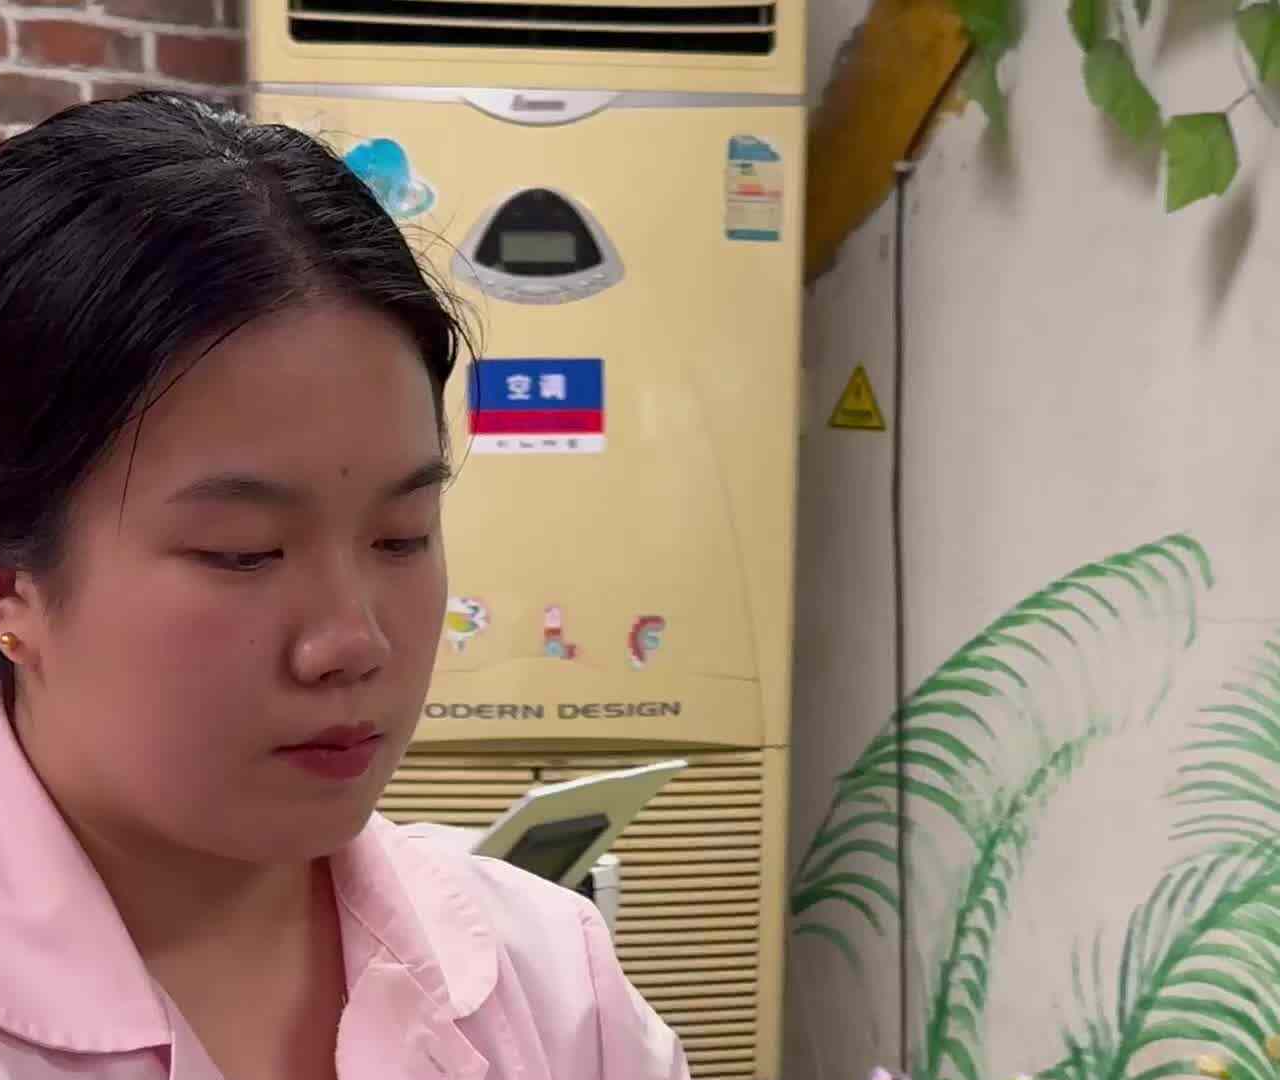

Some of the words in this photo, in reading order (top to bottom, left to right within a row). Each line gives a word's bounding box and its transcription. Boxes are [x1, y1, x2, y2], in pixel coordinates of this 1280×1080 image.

[505, 373, 567, 401] 空调
[422, 703, 545, 720] ODERN
[557, 701, 682, 720] DESIGN
